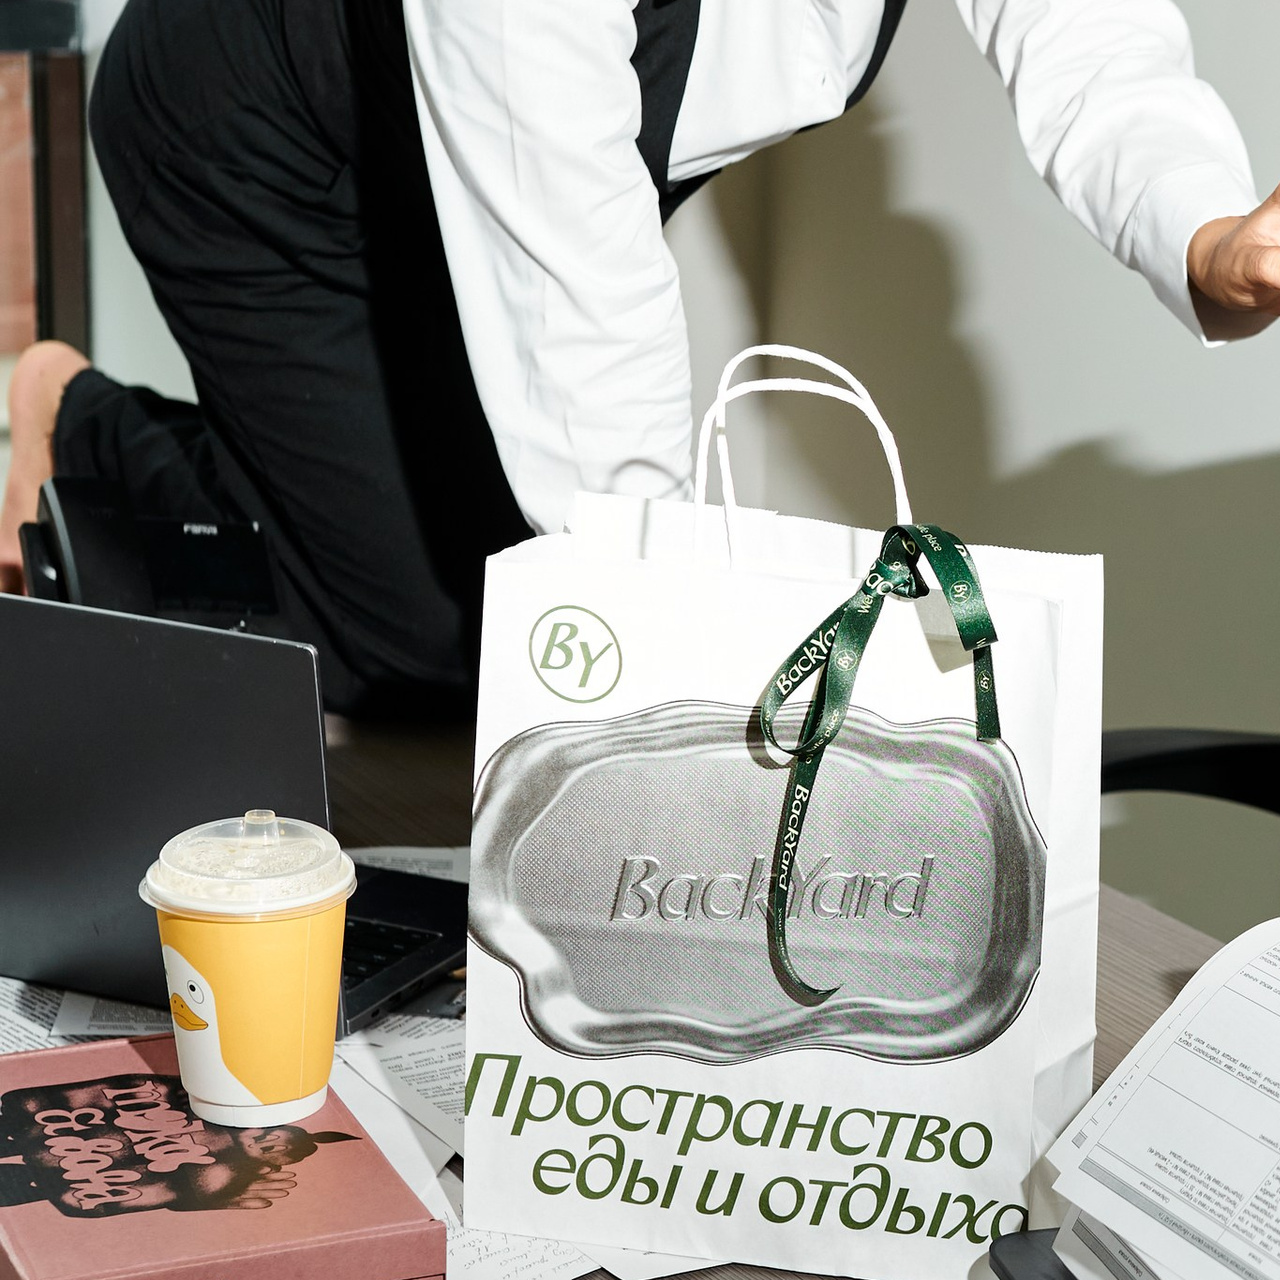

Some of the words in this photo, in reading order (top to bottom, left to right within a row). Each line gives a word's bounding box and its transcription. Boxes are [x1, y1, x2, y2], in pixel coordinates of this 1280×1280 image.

[538, 620, 614, 688] BY
[778, 783, 810, 892] BackYard
[607, 853, 934, 924] BackYard
[464, 1052, 994, 1172] Пространство
[531, 1134, 684, 1208] еды
[698, 1169, 734, 1217] и
